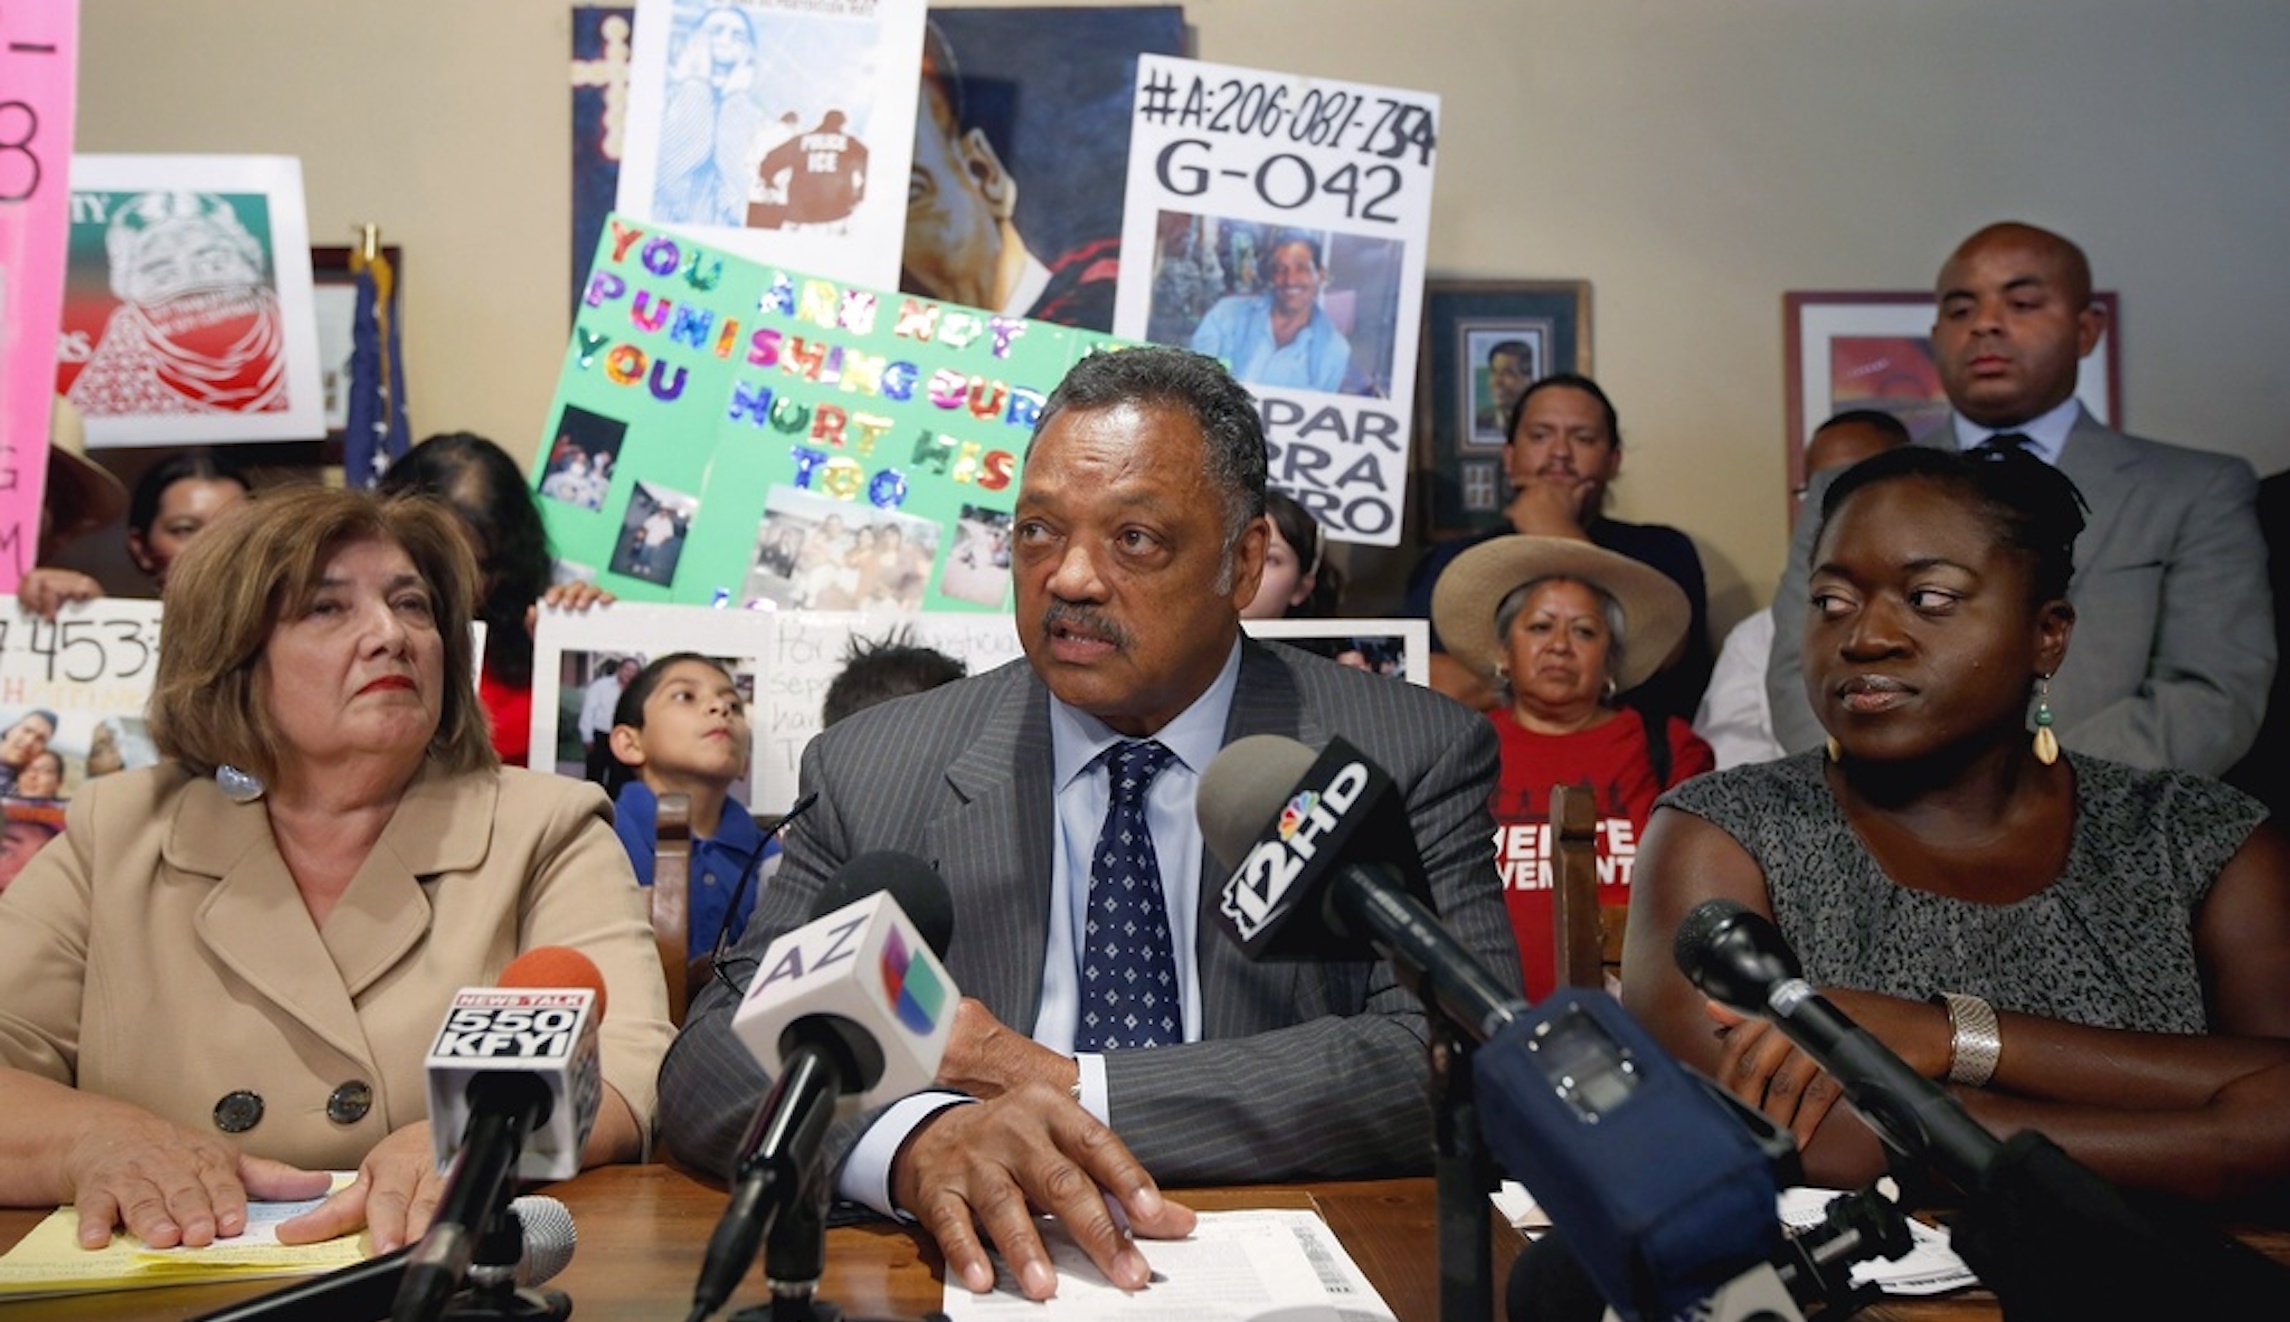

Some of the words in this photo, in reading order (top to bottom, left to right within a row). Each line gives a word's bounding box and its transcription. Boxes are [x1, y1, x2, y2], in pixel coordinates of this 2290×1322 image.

[807, 151, 838, 173] ICE
[611, 219, 723, 292] YOU
[894, 298, 1029, 359] NOT
[577, 325, 689, 402] YOU
[728, 379, 894, 457] HURT
[927, 367, 1047, 430] OUR
[1262, 398, 1402, 453] PAR
[791, 443, 907, 511] TOO
[1267, 485, 1394, 535] RO
[750, 914, 869, 1000] AZ
[449, 1009, 576, 1033] 550
[457, 994, 520, 1007] NEWS
[527, 994, 584, 1007] TALK
[436, 1032, 570, 1057] KFYI
